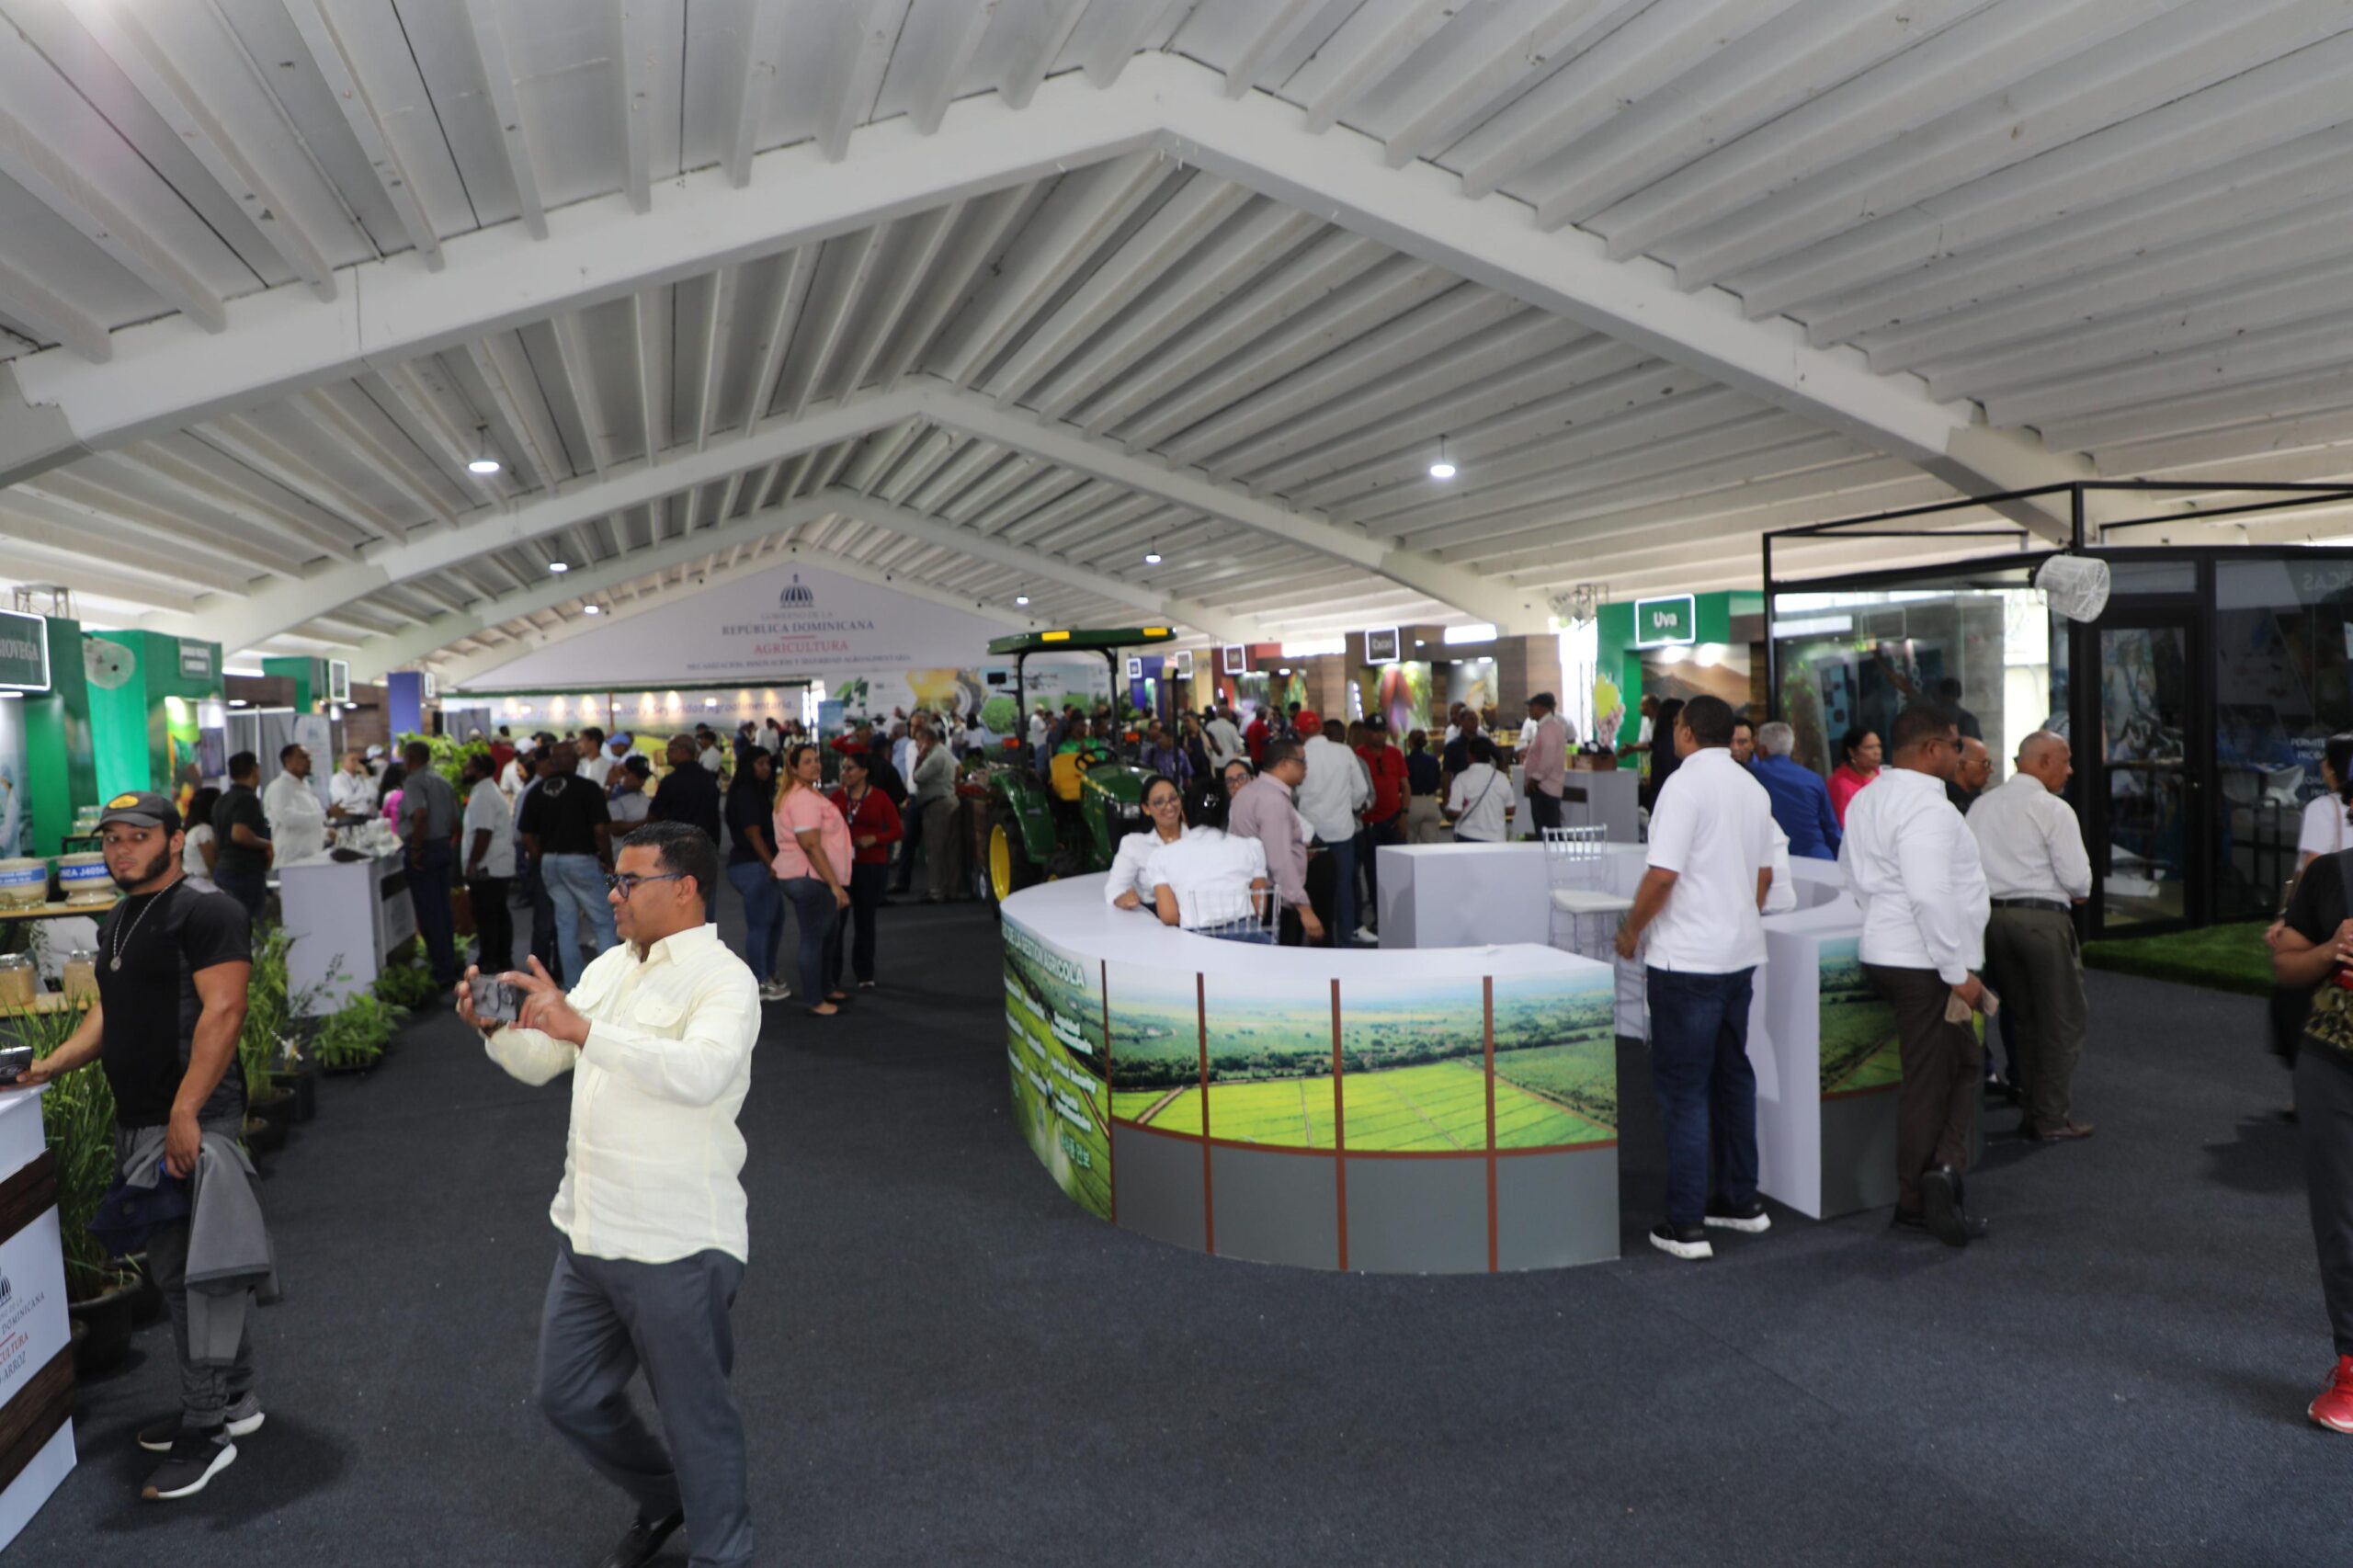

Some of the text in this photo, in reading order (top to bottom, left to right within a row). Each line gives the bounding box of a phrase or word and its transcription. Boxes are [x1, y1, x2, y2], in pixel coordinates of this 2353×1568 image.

[792, 620, 875, 633] DOMINICANA
[1654, 611, 1677, 628] Uva
[754, 641, 849, 654] AGRICULTURA
[2, 1290, 45, 1335] DOMINICANA
